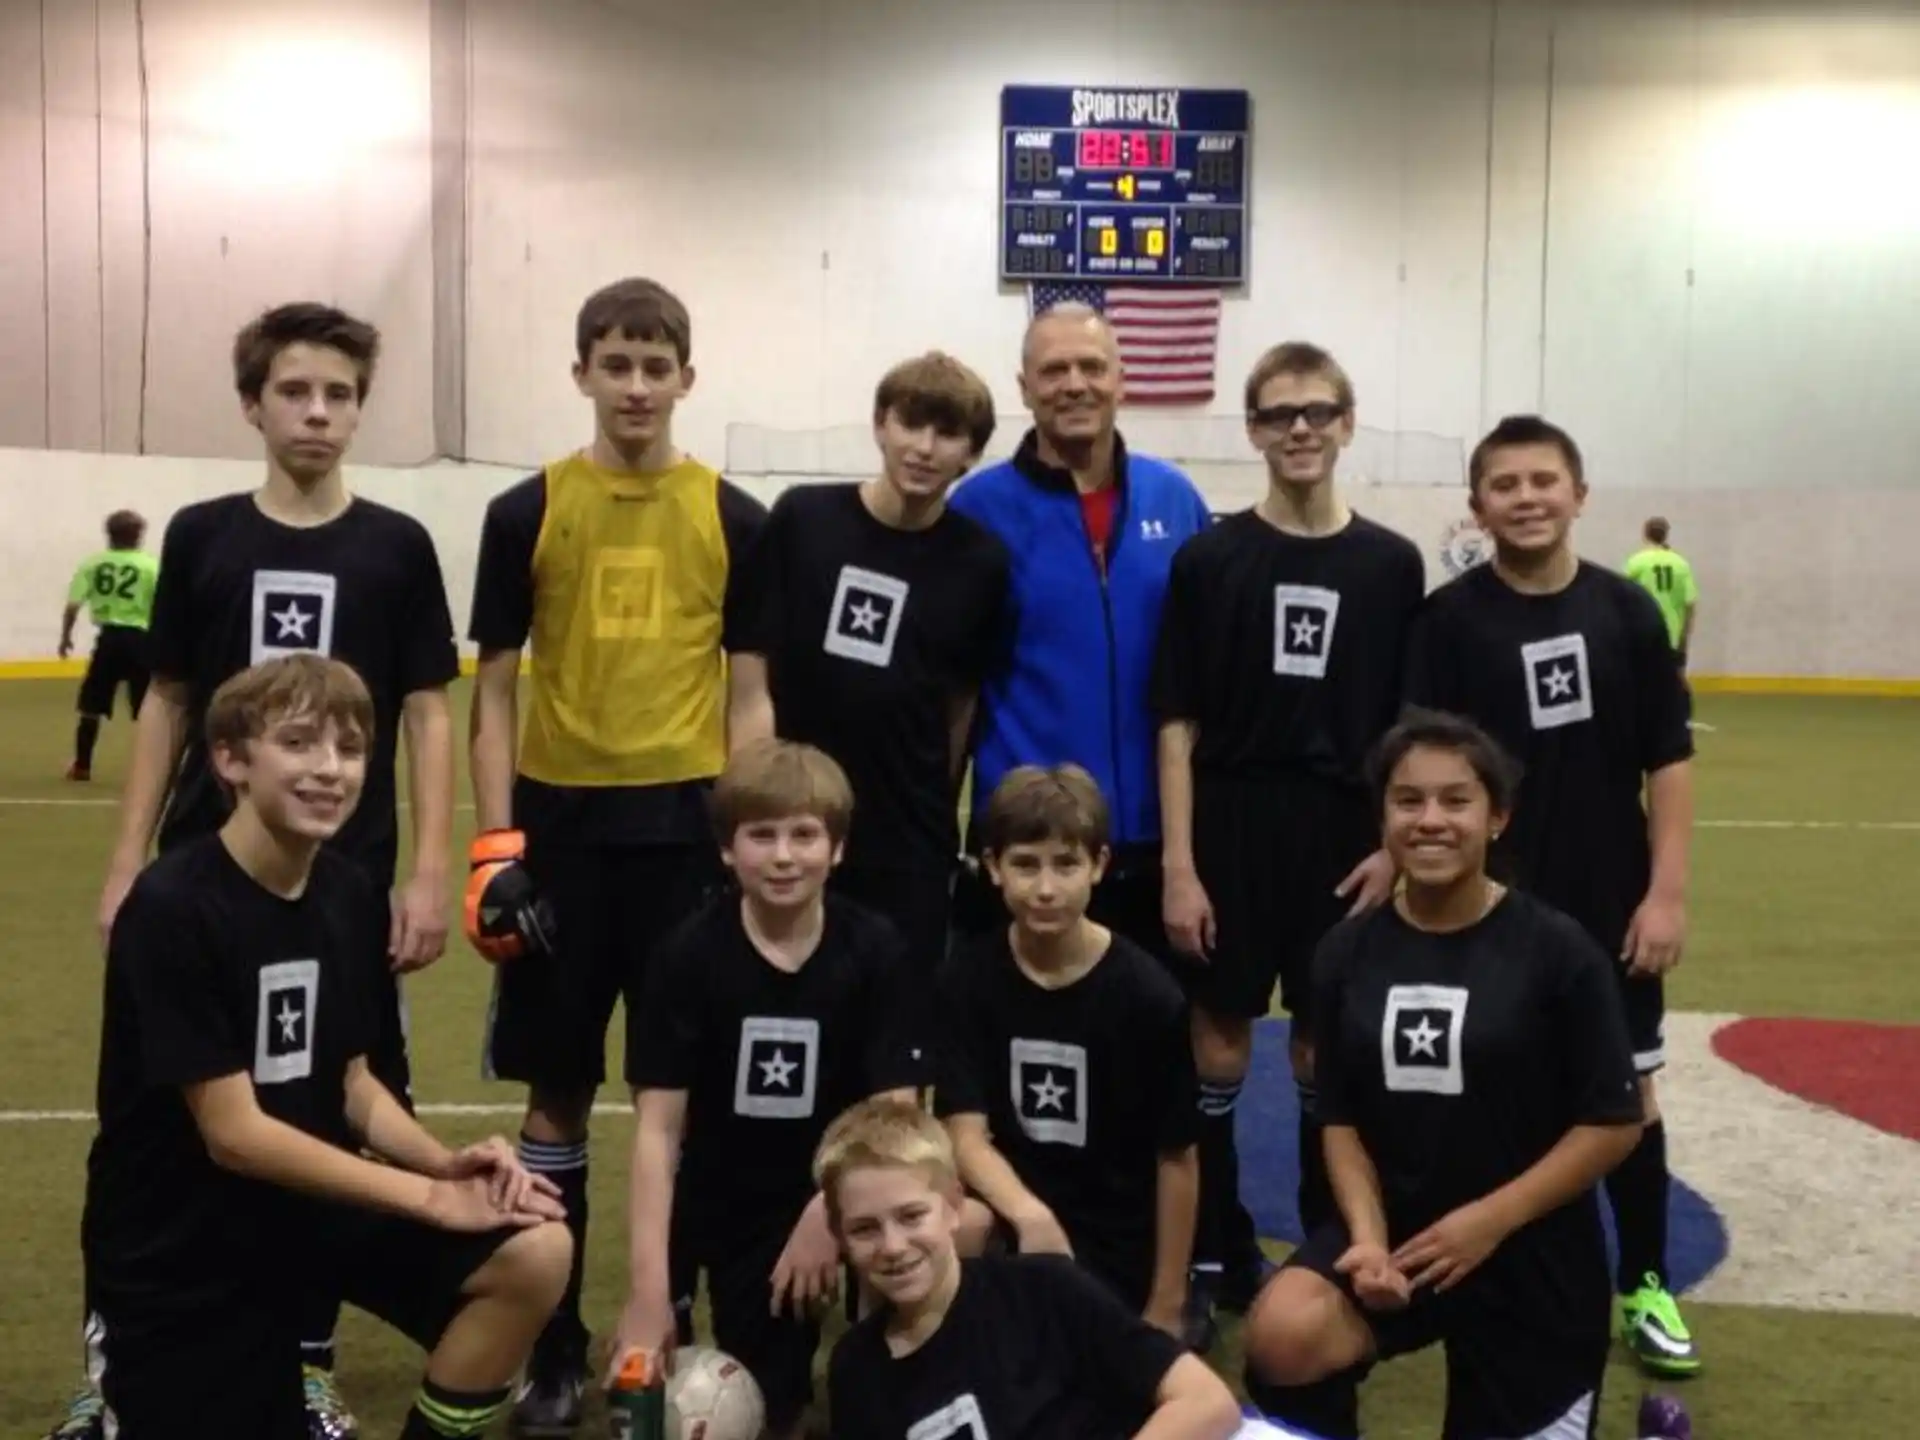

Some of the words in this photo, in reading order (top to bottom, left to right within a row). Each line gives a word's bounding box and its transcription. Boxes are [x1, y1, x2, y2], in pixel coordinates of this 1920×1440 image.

[1072, 89, 1180, 129] SPORTSPLEX
[1014, 131, 1054, 148] HOME
[1196, 136, 1237, 152] AWAY
[94, 561, 139, 600] 62
[1652, 563, 1674, 594] 11
